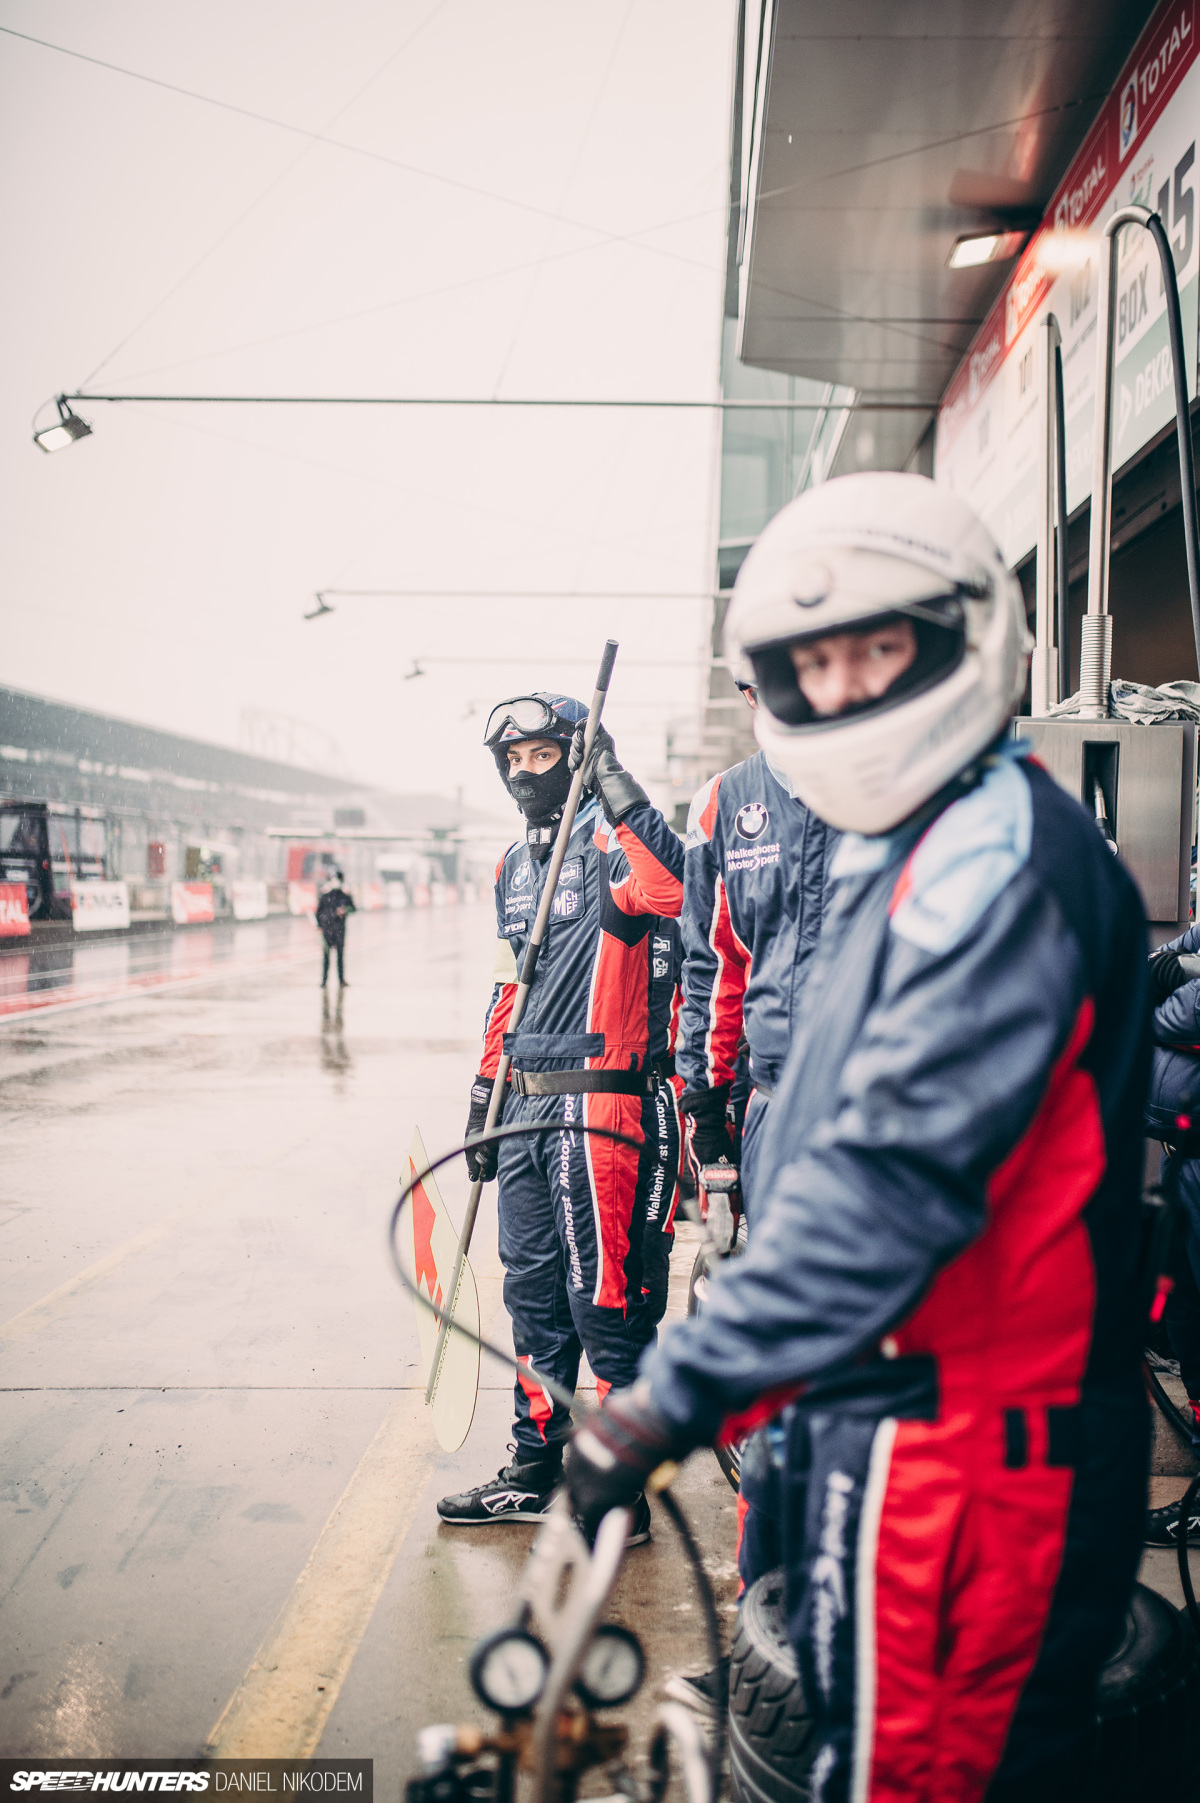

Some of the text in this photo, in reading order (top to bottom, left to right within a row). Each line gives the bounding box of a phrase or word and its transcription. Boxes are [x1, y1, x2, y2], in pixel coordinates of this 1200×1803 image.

[1140, 10, 1191, 106] TOTAL
[1069, 154, 1106, 226] TOTAL
[1119, 264, 1149, 346] BOX
[740, 804, 766, 817] BMW
[726, 843, 780, 861] Walkenhorst
[646, 1144, 668, 1221] Walkenhrst
[561, 1195, 584, 1289] Walkenhorst
